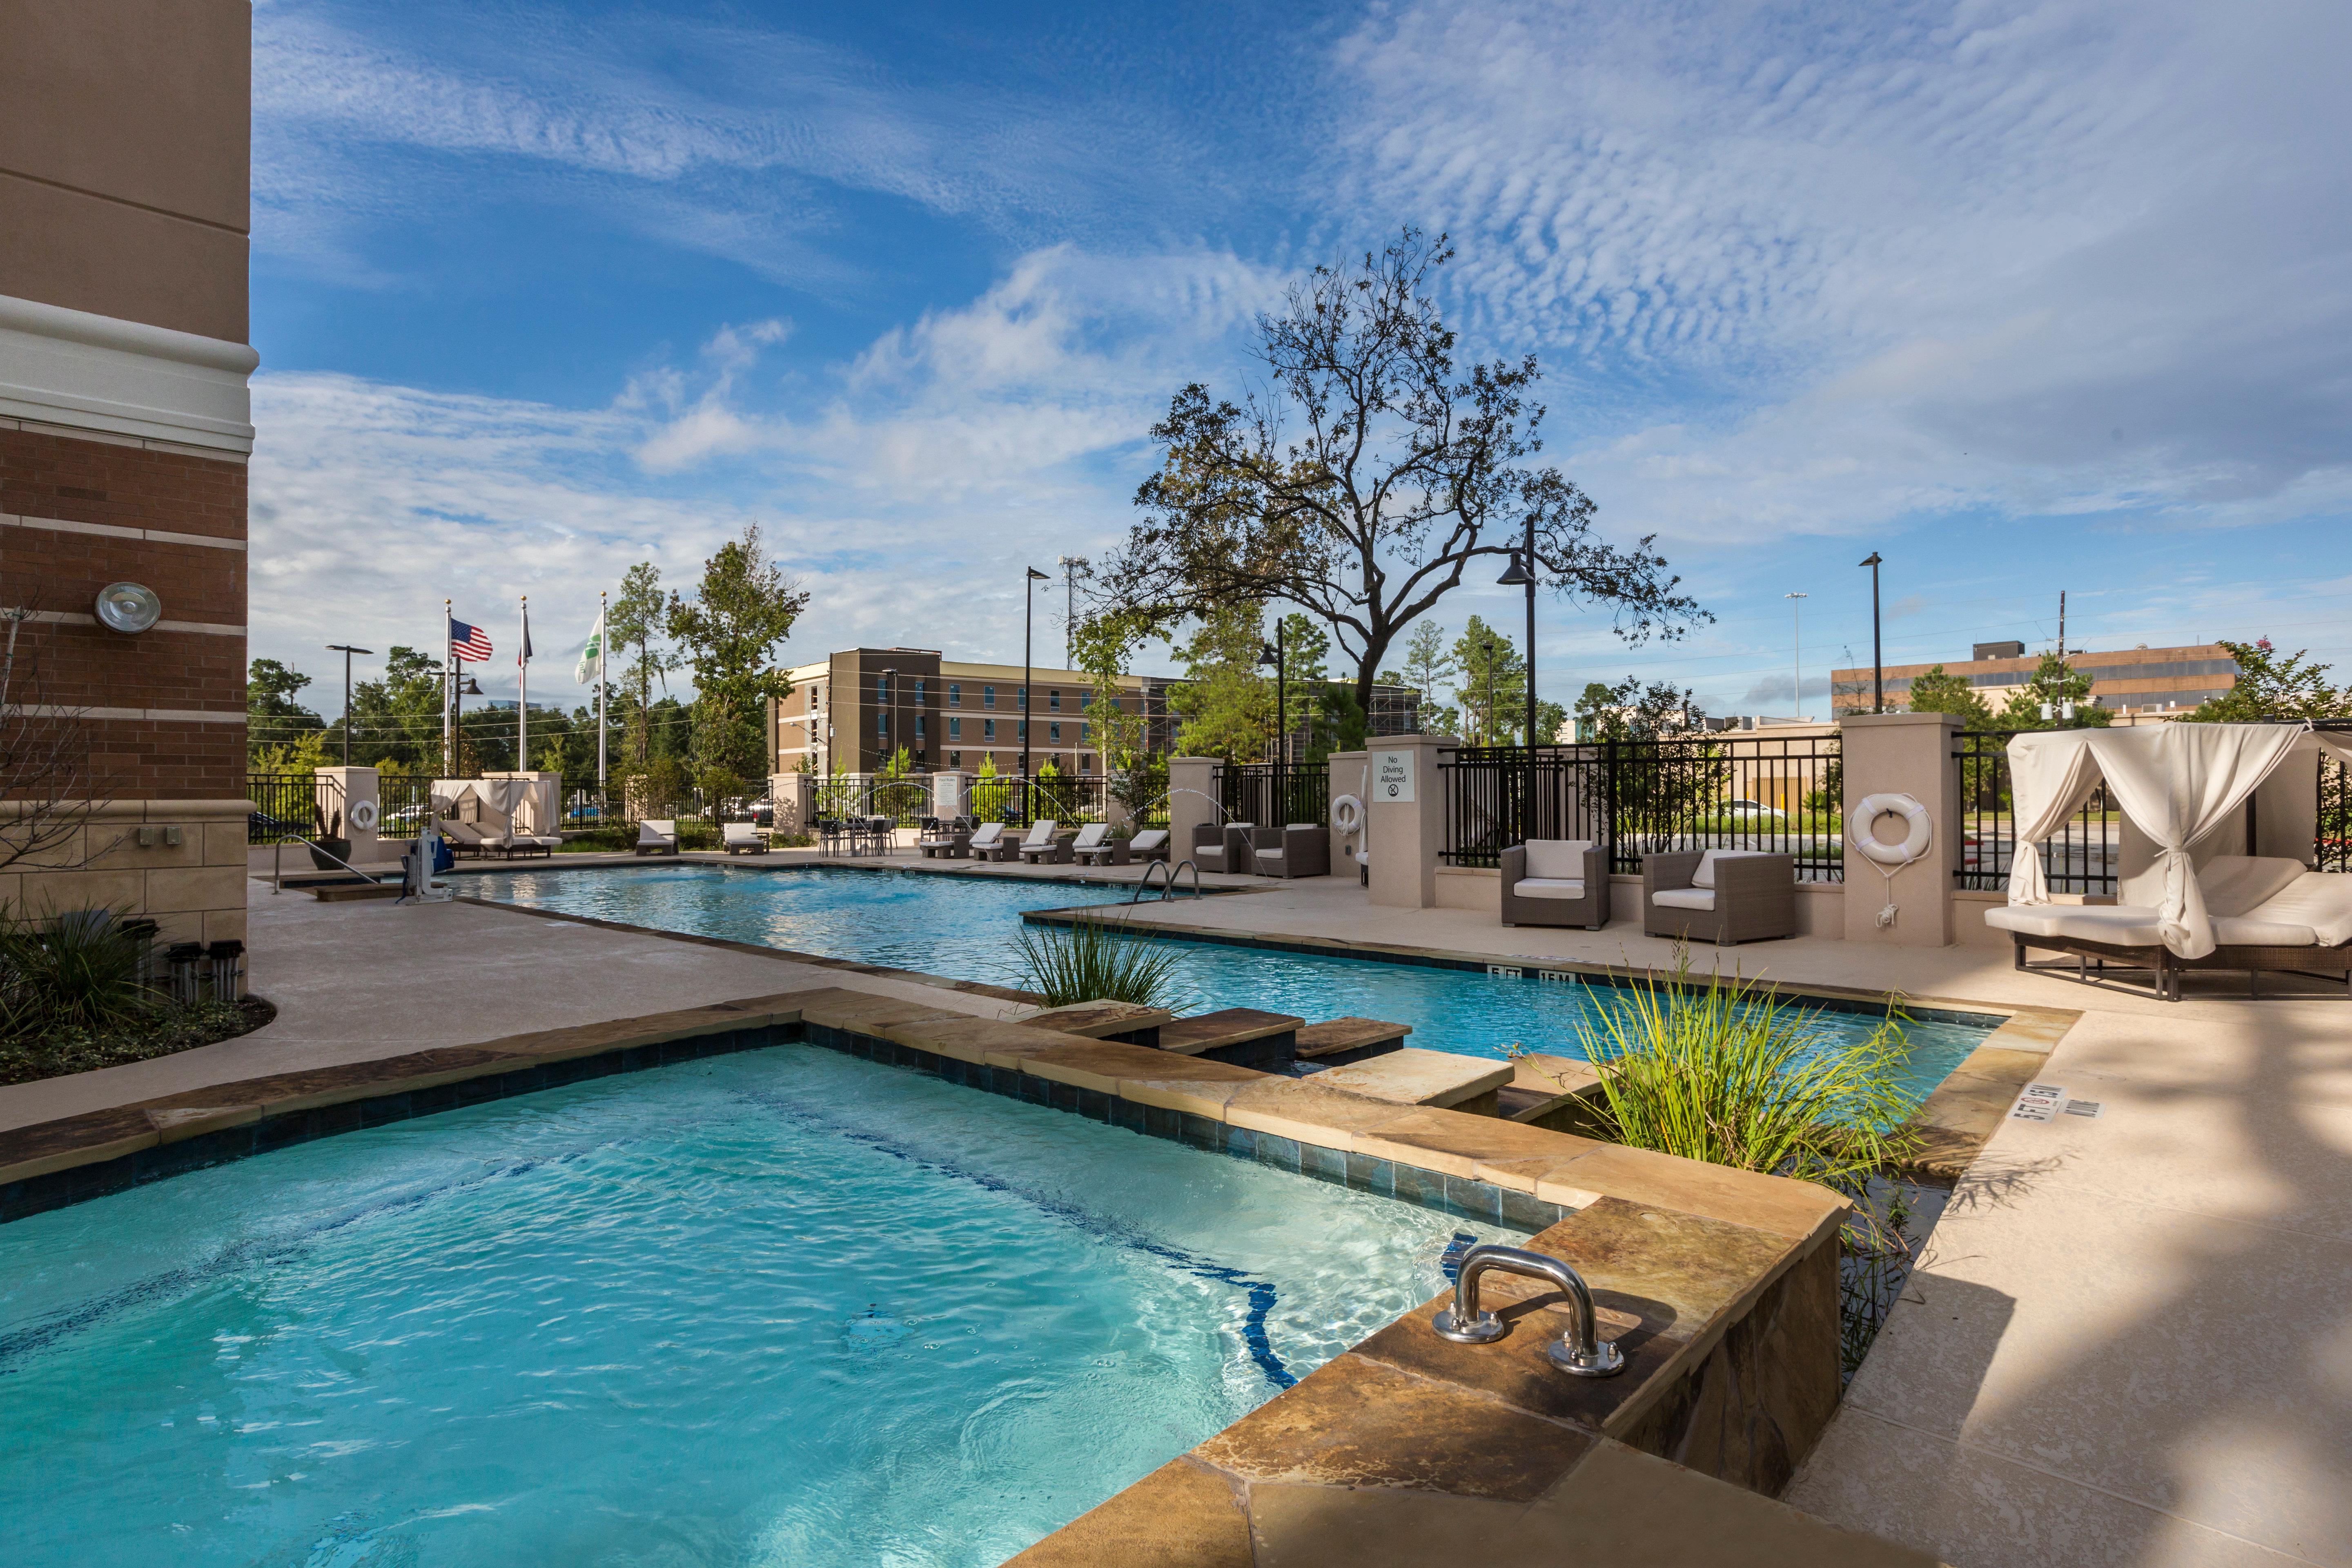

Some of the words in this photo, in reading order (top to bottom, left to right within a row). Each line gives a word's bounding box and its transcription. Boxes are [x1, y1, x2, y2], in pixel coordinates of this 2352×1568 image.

[1383, 766, 1403, 775] Diving
[1381, 775, 1406, 783] Allowed
[2017, 1104, 2050, 1114] FT
